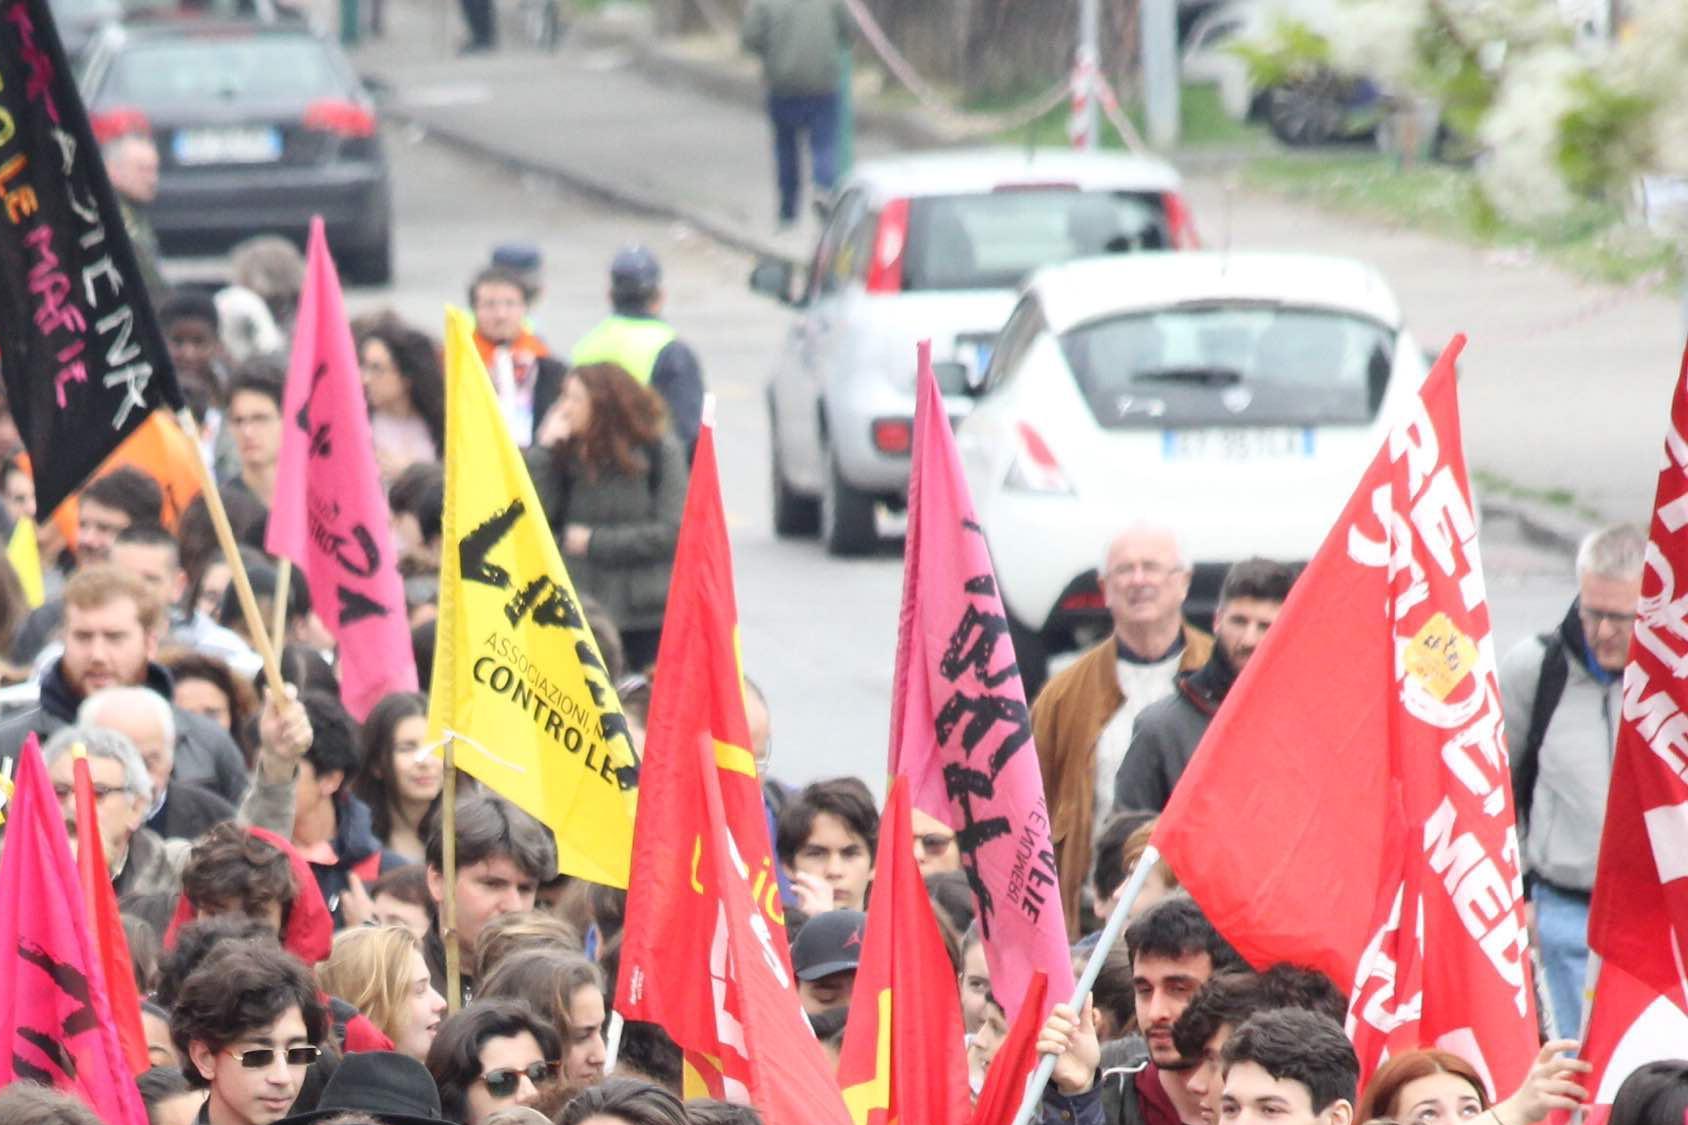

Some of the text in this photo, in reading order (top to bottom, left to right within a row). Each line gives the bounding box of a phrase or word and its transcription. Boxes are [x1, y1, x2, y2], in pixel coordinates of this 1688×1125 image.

[25, 224, 89, 410] MAFIE
[473, 656, 584, 753] CONTRO
[484, 631, 592, 735] ASSOCIAZIONI,
